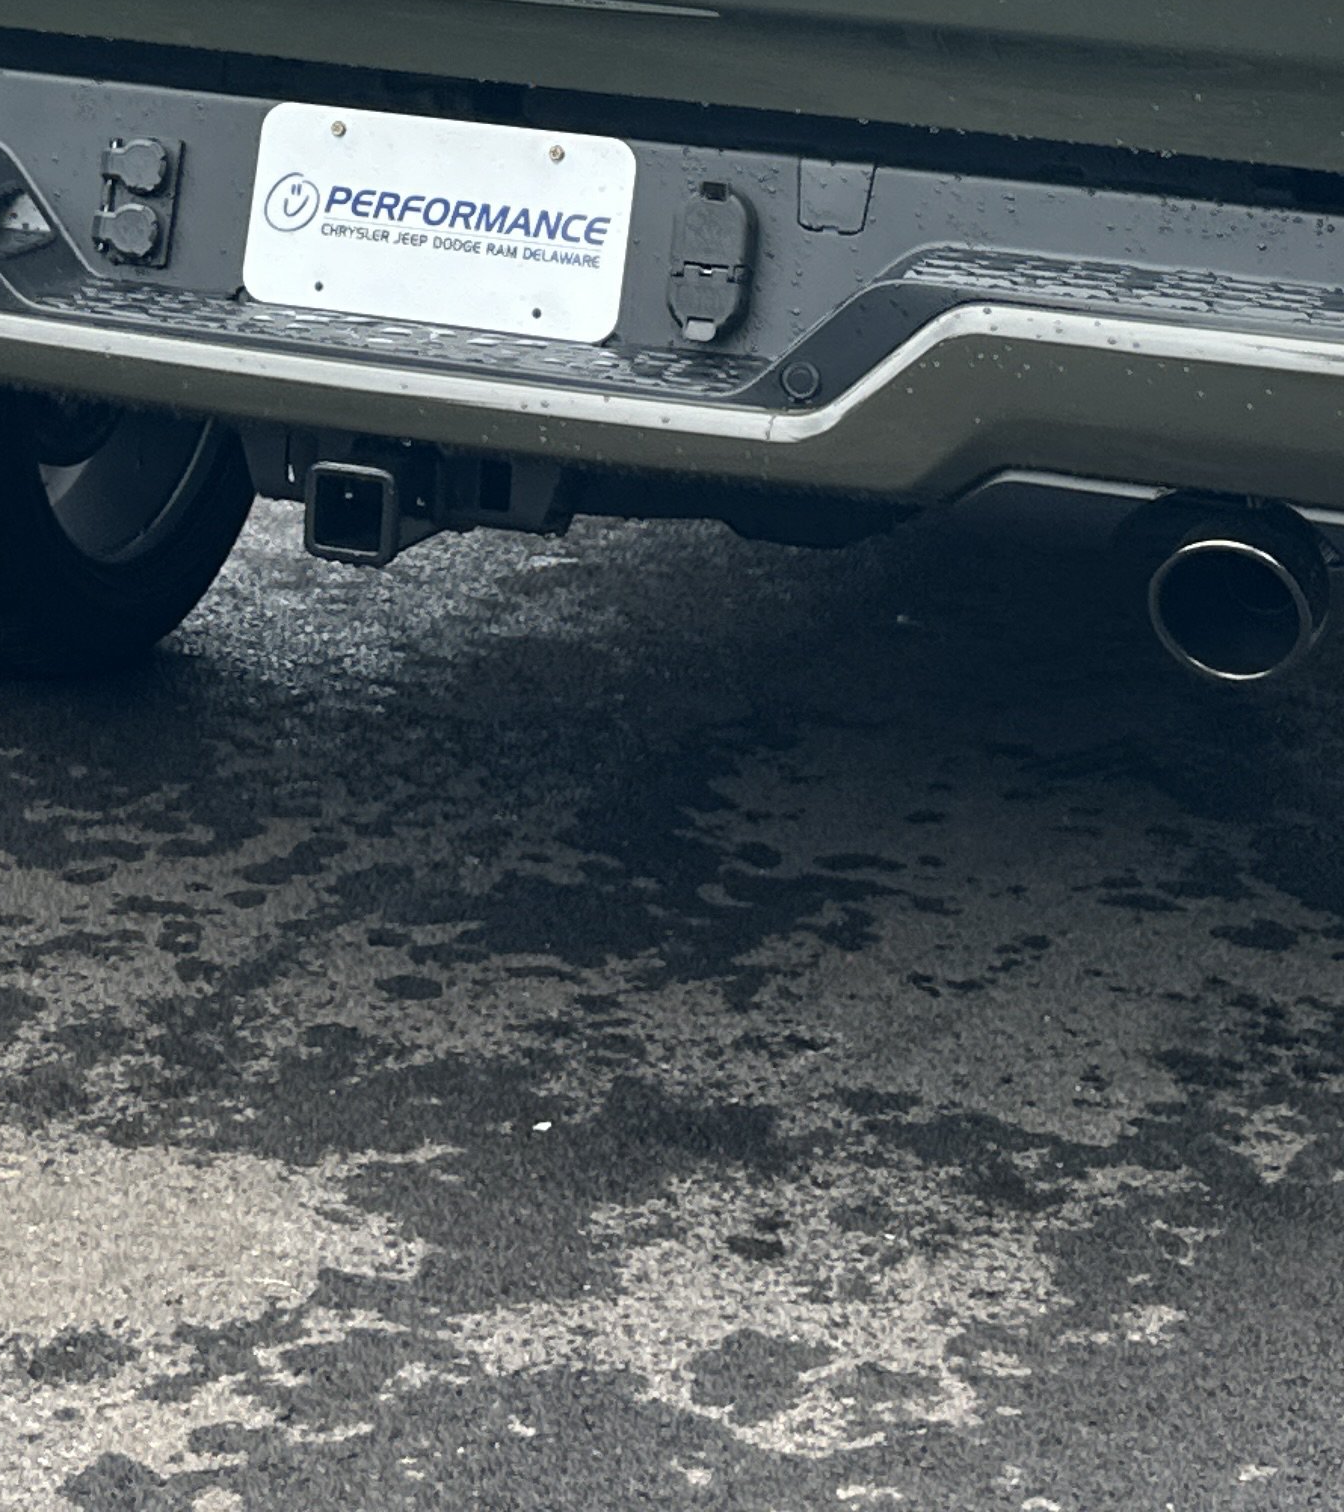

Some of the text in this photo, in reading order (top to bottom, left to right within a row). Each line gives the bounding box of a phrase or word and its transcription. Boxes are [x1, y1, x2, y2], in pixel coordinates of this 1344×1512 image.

[323, 185, 612, 246] PERFORMANCE
[320, 222, 601, 269] CHRYSLER JEEP DODGE RAM DELAWARE
